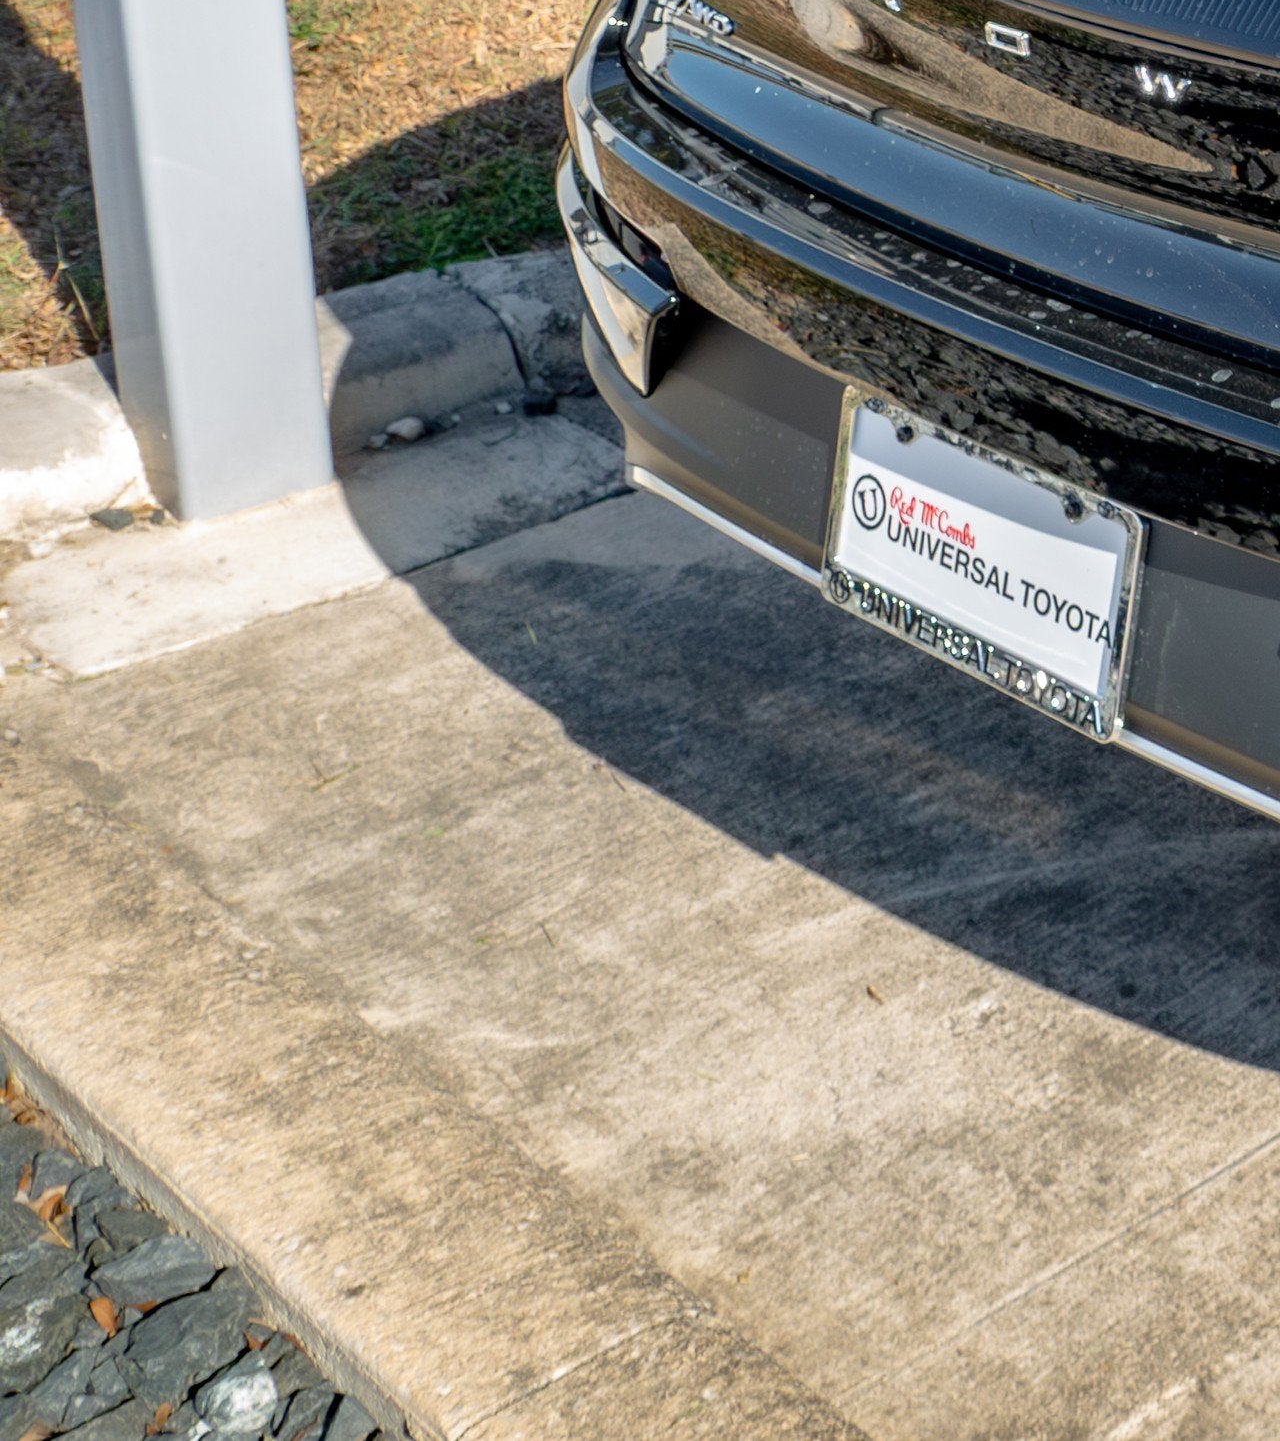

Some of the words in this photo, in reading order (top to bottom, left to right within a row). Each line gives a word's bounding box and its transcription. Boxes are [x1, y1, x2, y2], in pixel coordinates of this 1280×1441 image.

[887, 514, 1015, 601] UNIVERSAL
[1020, 578, 1112, 649] TOYOTA
[890, 485, 917, 526] Red
[919, 499, 977, 550] McCombs
[859, 580, 999, 680] UNIVERSAL
[1004, 656, 1104, 735] TOYOTA
